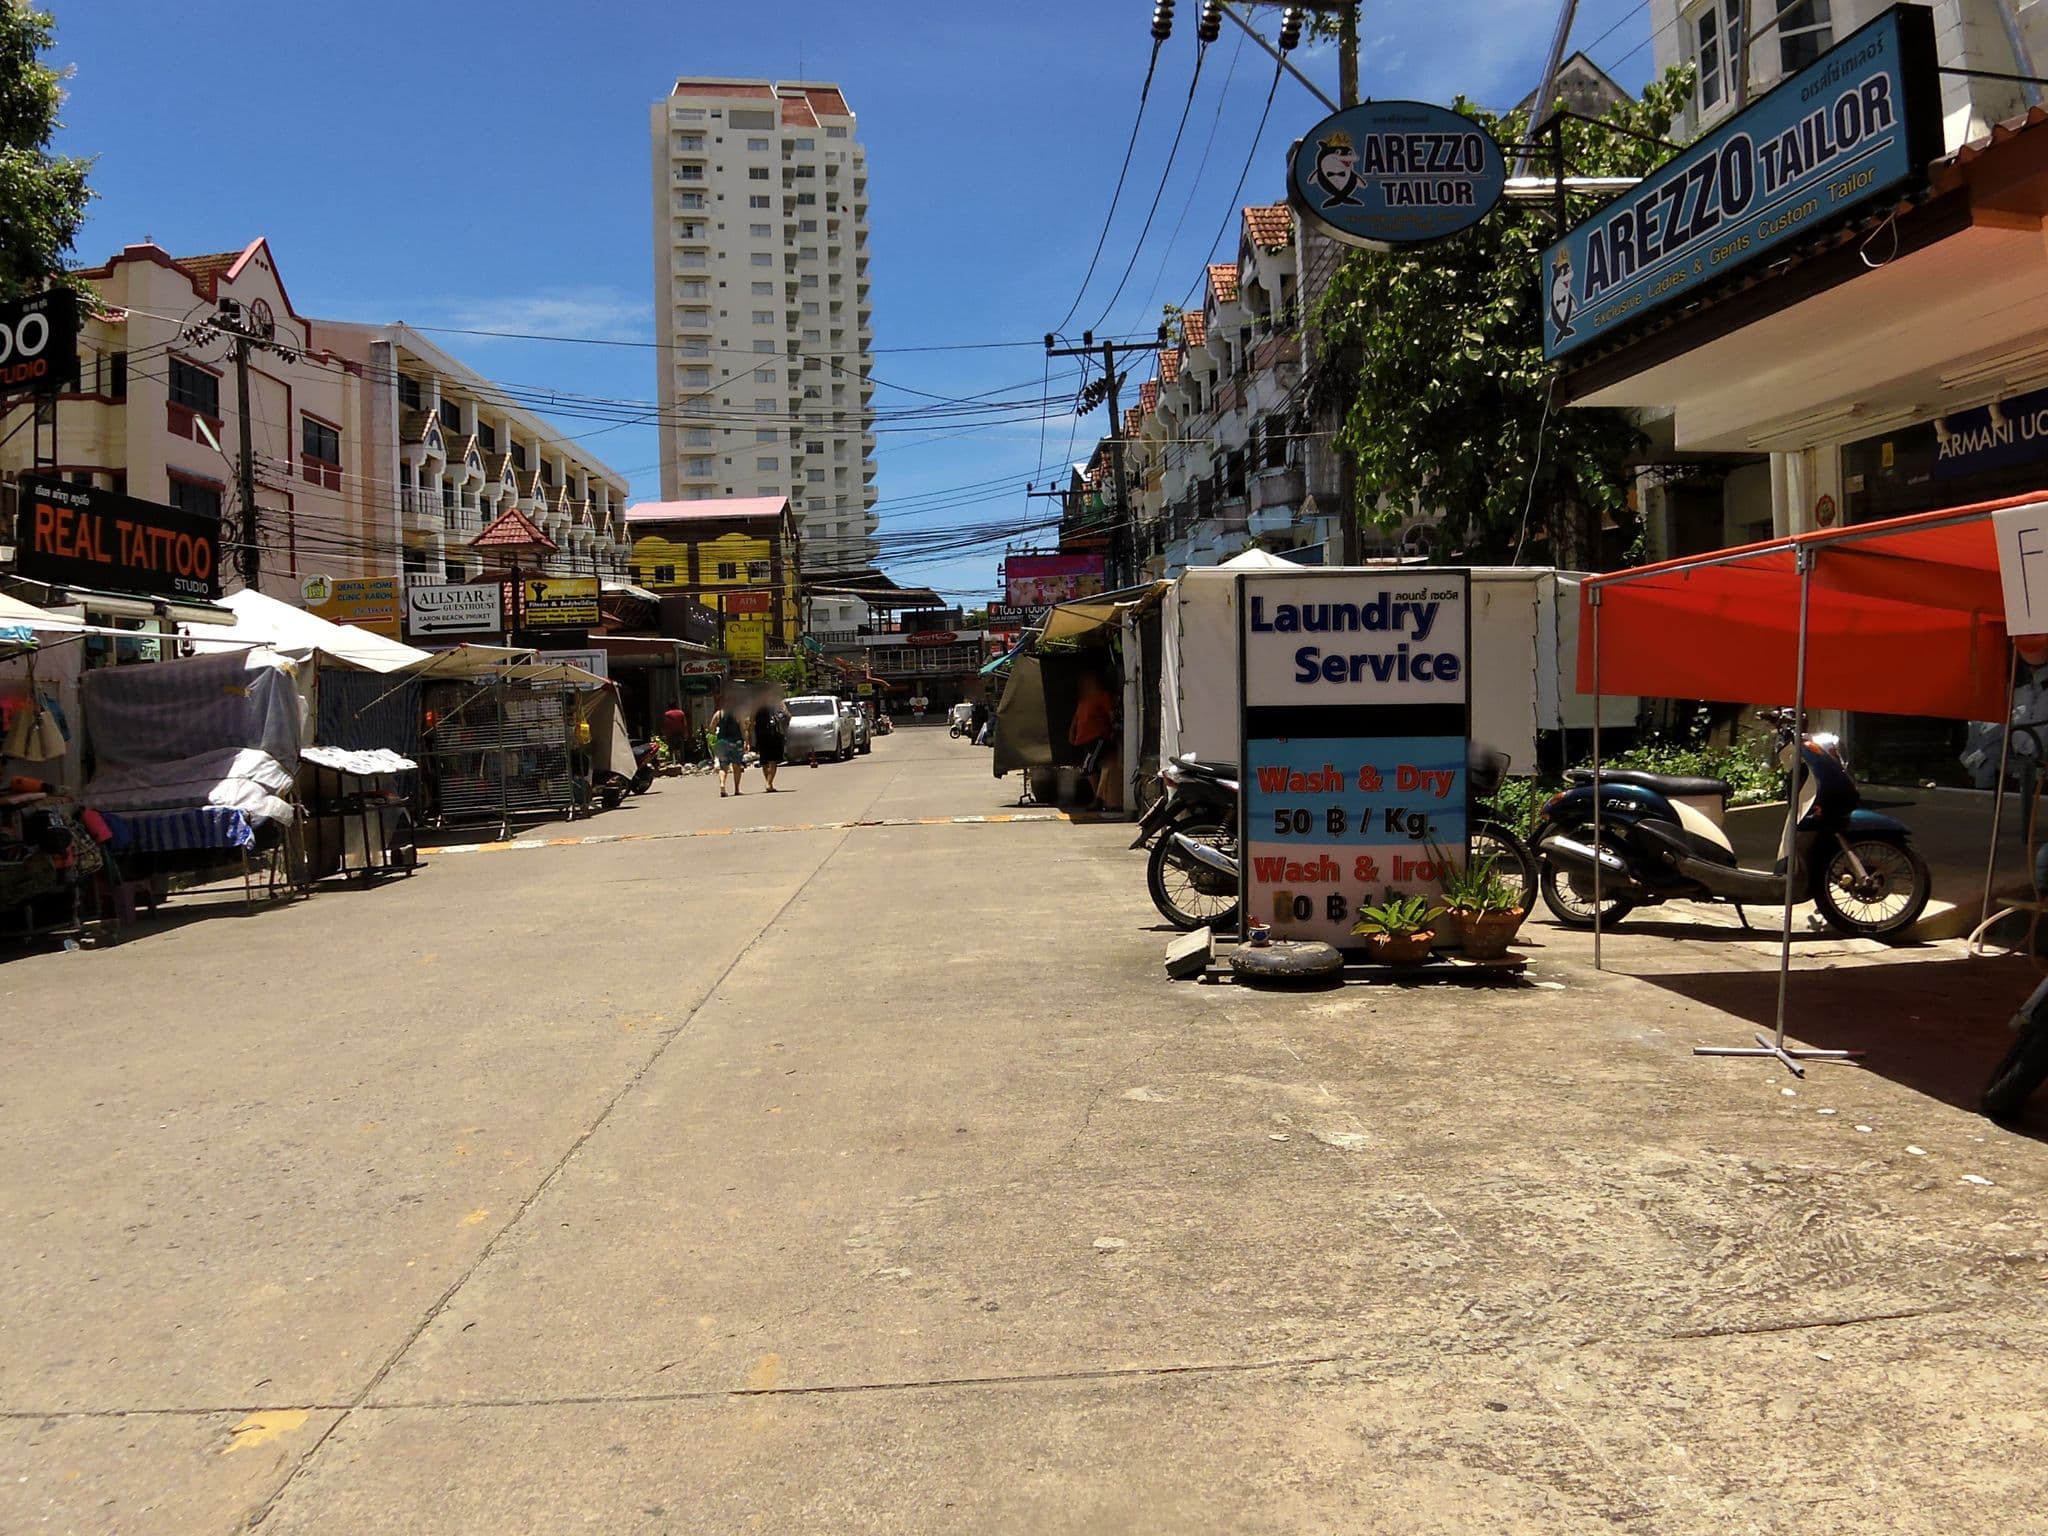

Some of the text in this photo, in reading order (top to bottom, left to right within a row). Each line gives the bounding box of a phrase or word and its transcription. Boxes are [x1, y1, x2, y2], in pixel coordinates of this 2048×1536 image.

[1363, 133, 1485, 175] AREZZO
[1381, 180, 1475, 207] TAILOR
[1583, 71, 1898, 304] AREZZO TAILOR
[1593, 167, 1876, 328] Exclusive Ladies & Gents Custom Tailor
[1938, 418, 2014, 460] ARMANI
[35, 503, 211, 579] REAL TATTOO
[174, 578, 209, 594] STUDIO
[369, 581, 392, 589] HOME
[419, 590, 484, 606] ALLSTAR
[740, 597, 757, 605] ATM
[443, 602, 496, 611] GUESTHOUSE
[1251, 592, 1440, 641] Laundry
[1295, 643, 1460, 684] Service
[1257, 764, 1455, 799] Wash & Dry
[1274, 808, 1313, 835] 50
[1360, 808, 1373, 834] /
[1385, 808, 1438, 840] Kg.
[1253, 854, 1340, 883] Wash
[1354, 855, 1379, 882] &
